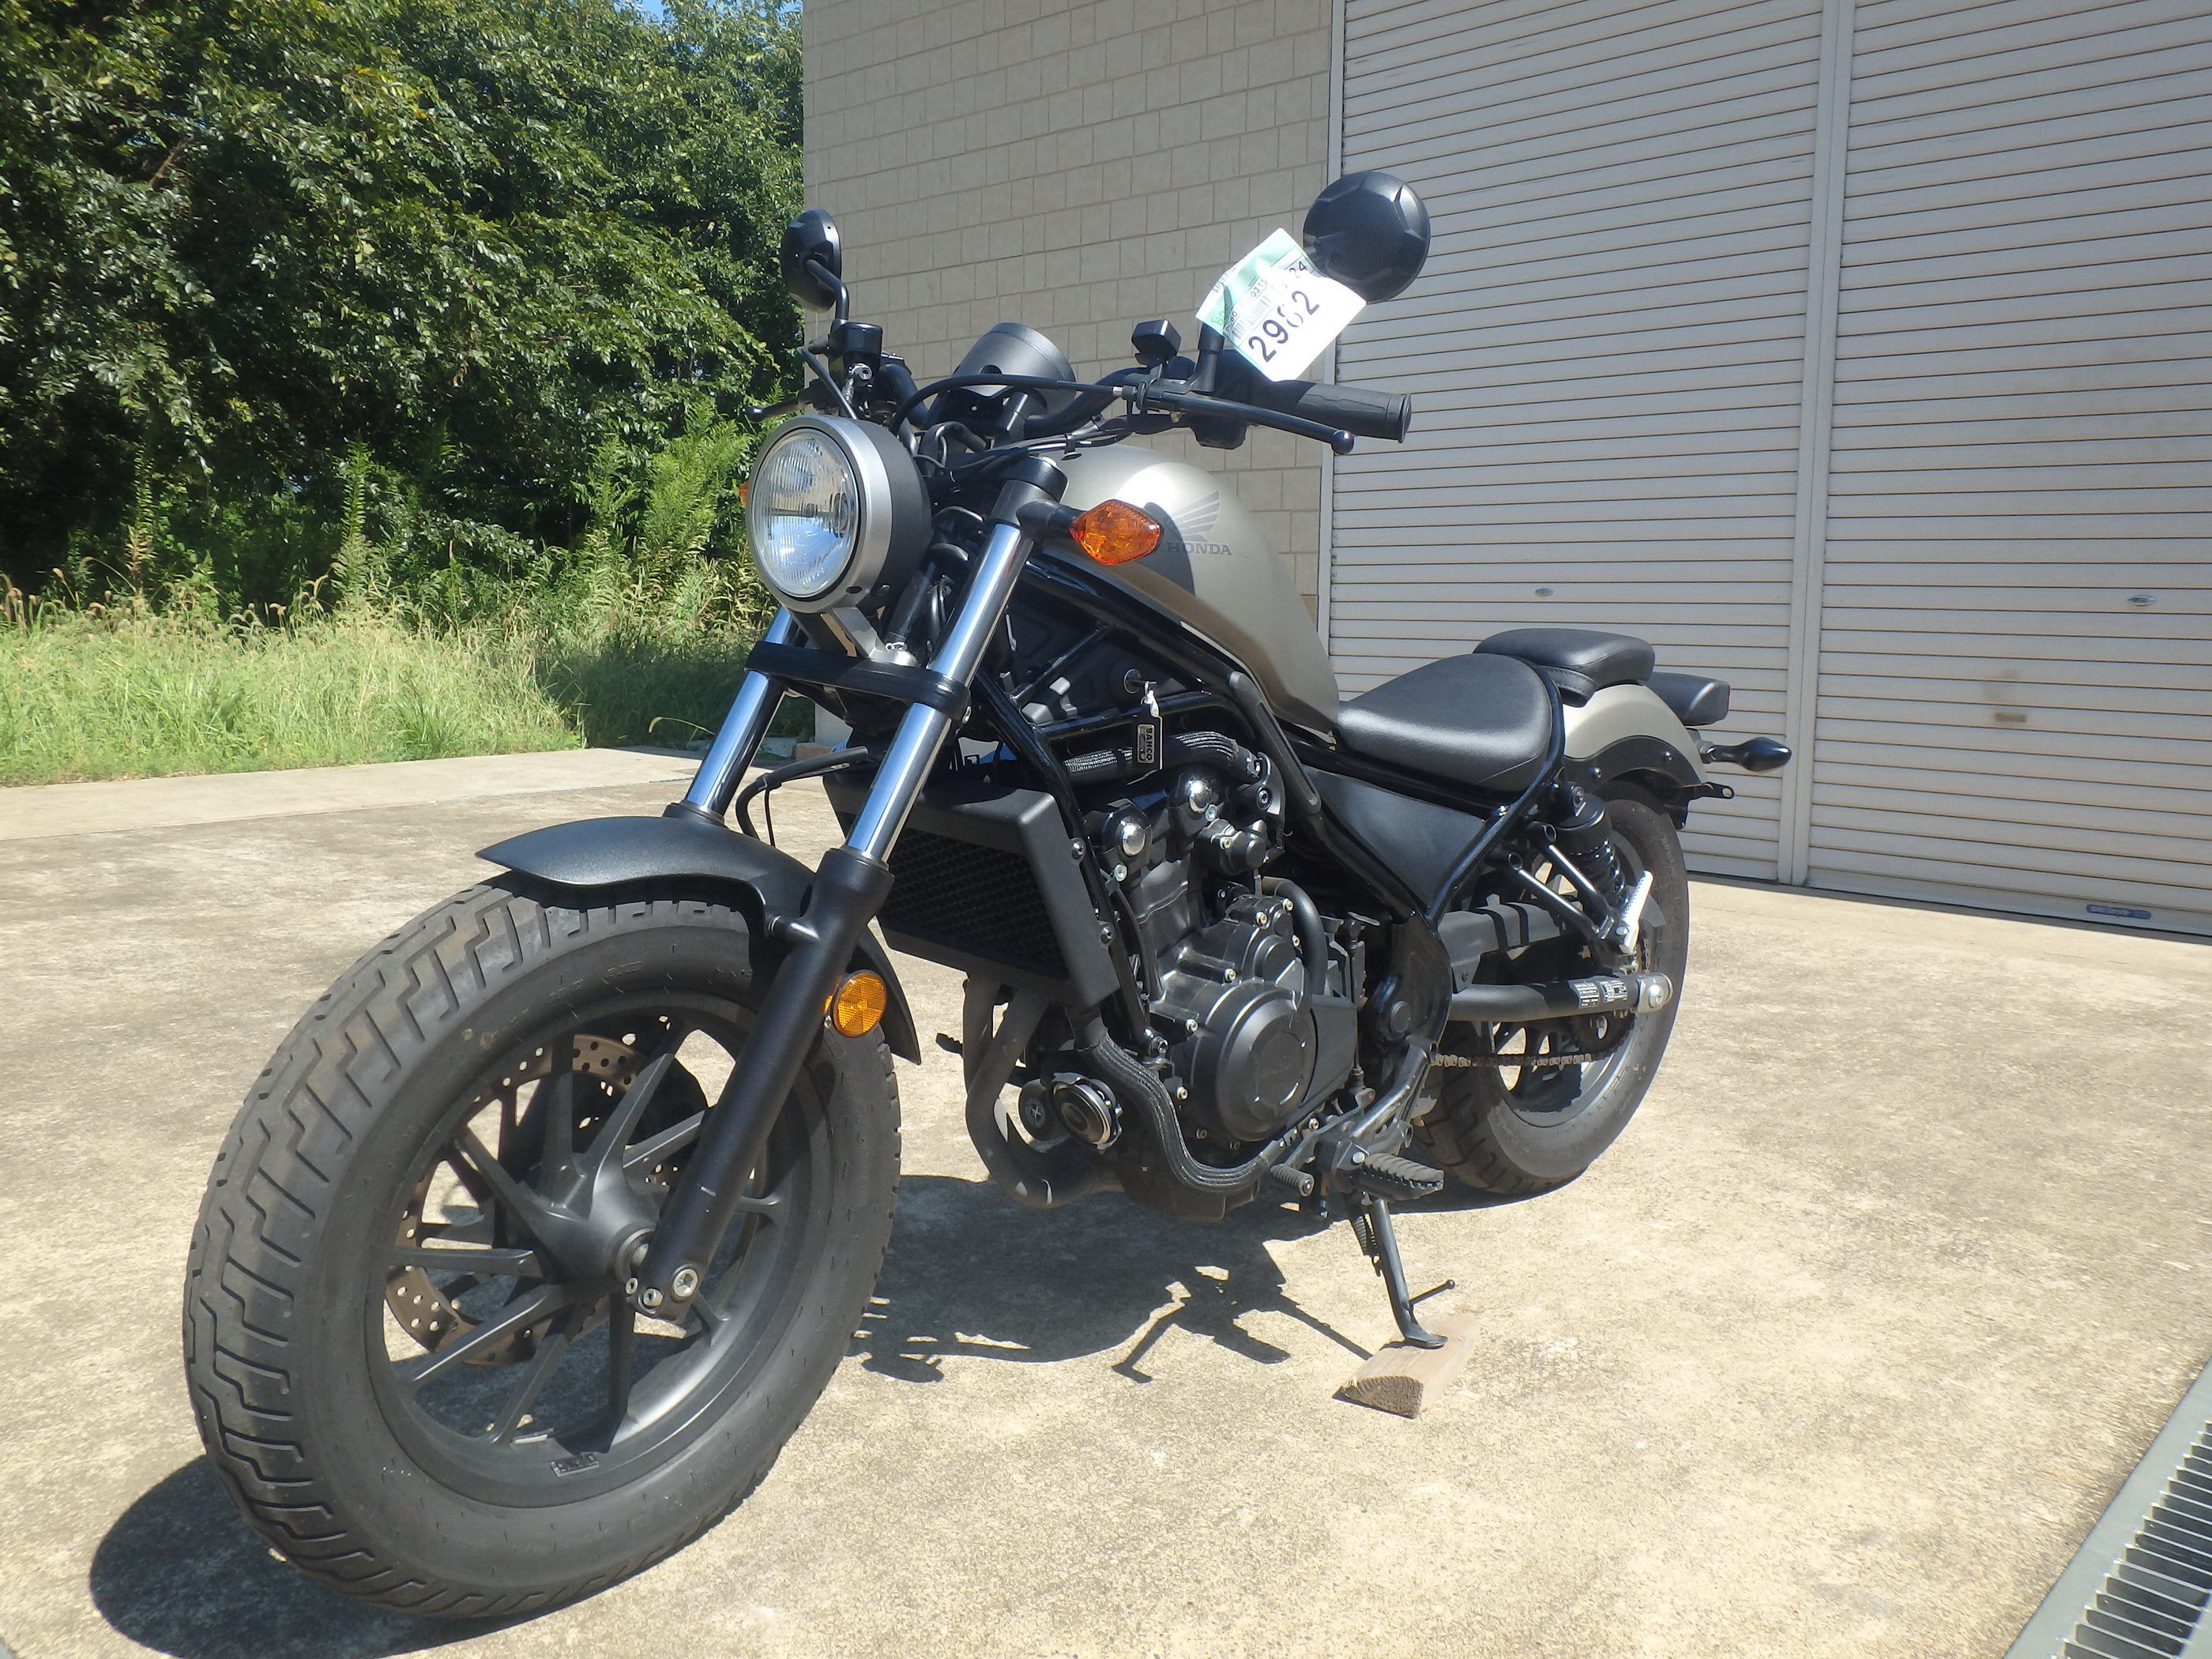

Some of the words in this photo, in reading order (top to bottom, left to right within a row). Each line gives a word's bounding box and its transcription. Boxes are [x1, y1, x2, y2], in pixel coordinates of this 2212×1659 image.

[1225, 278, 1267, 332] PC60-0315
[1248, 290, 1320, 363] 2982
[1167, 542, 1232, 555] HONDA
